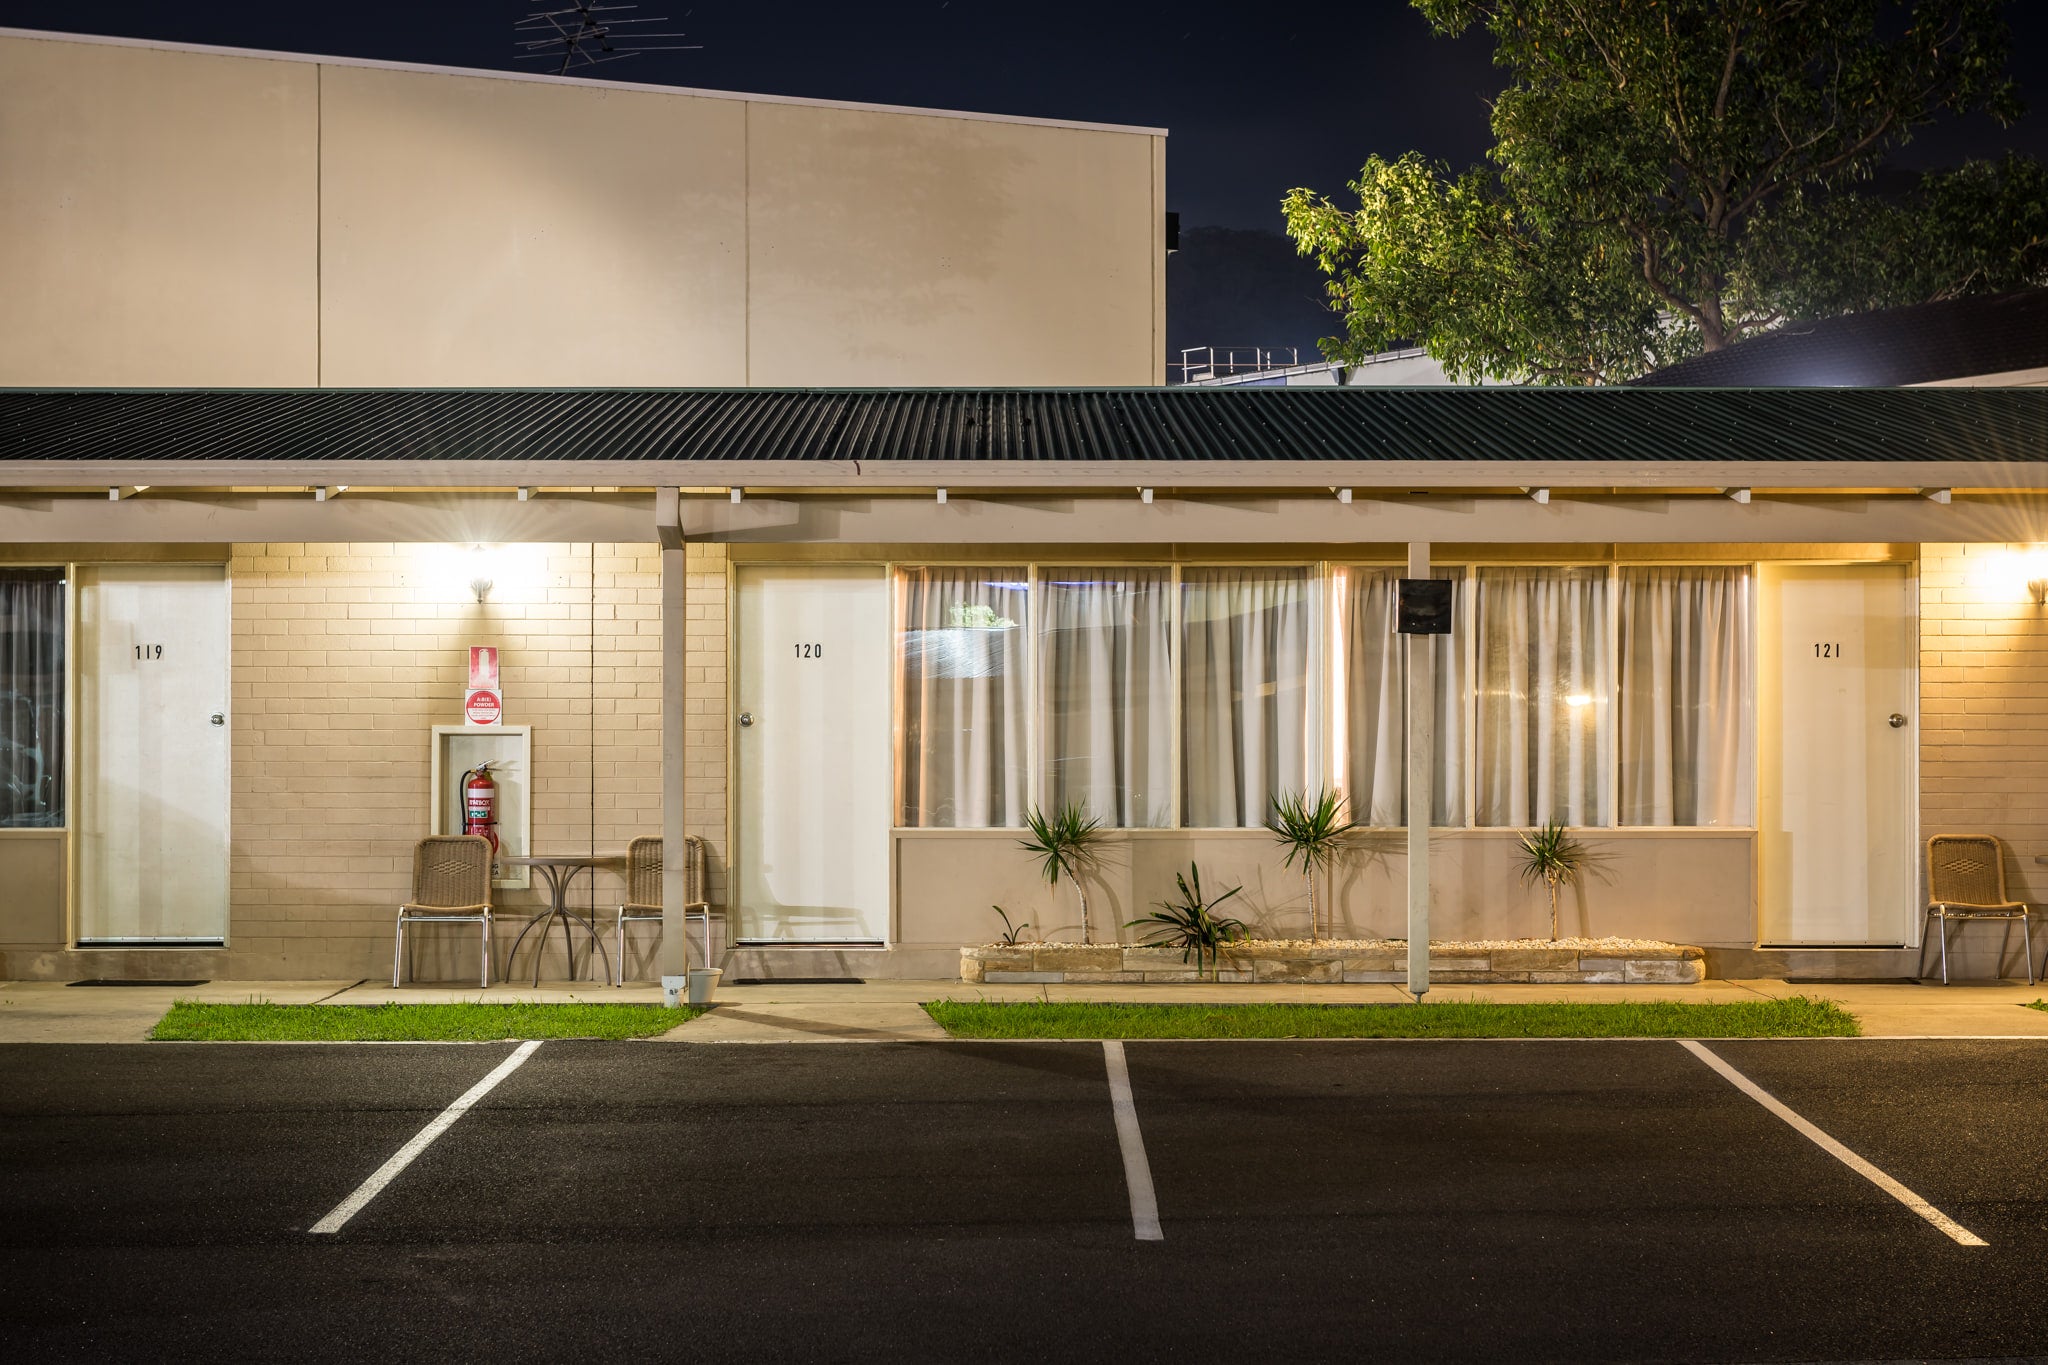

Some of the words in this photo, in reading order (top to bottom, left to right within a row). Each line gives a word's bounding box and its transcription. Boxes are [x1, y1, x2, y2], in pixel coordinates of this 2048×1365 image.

[135, 644, 162, 660] 119
[794, 643, 822, 659] 120
[1814, 643, 1840, 658] 121
